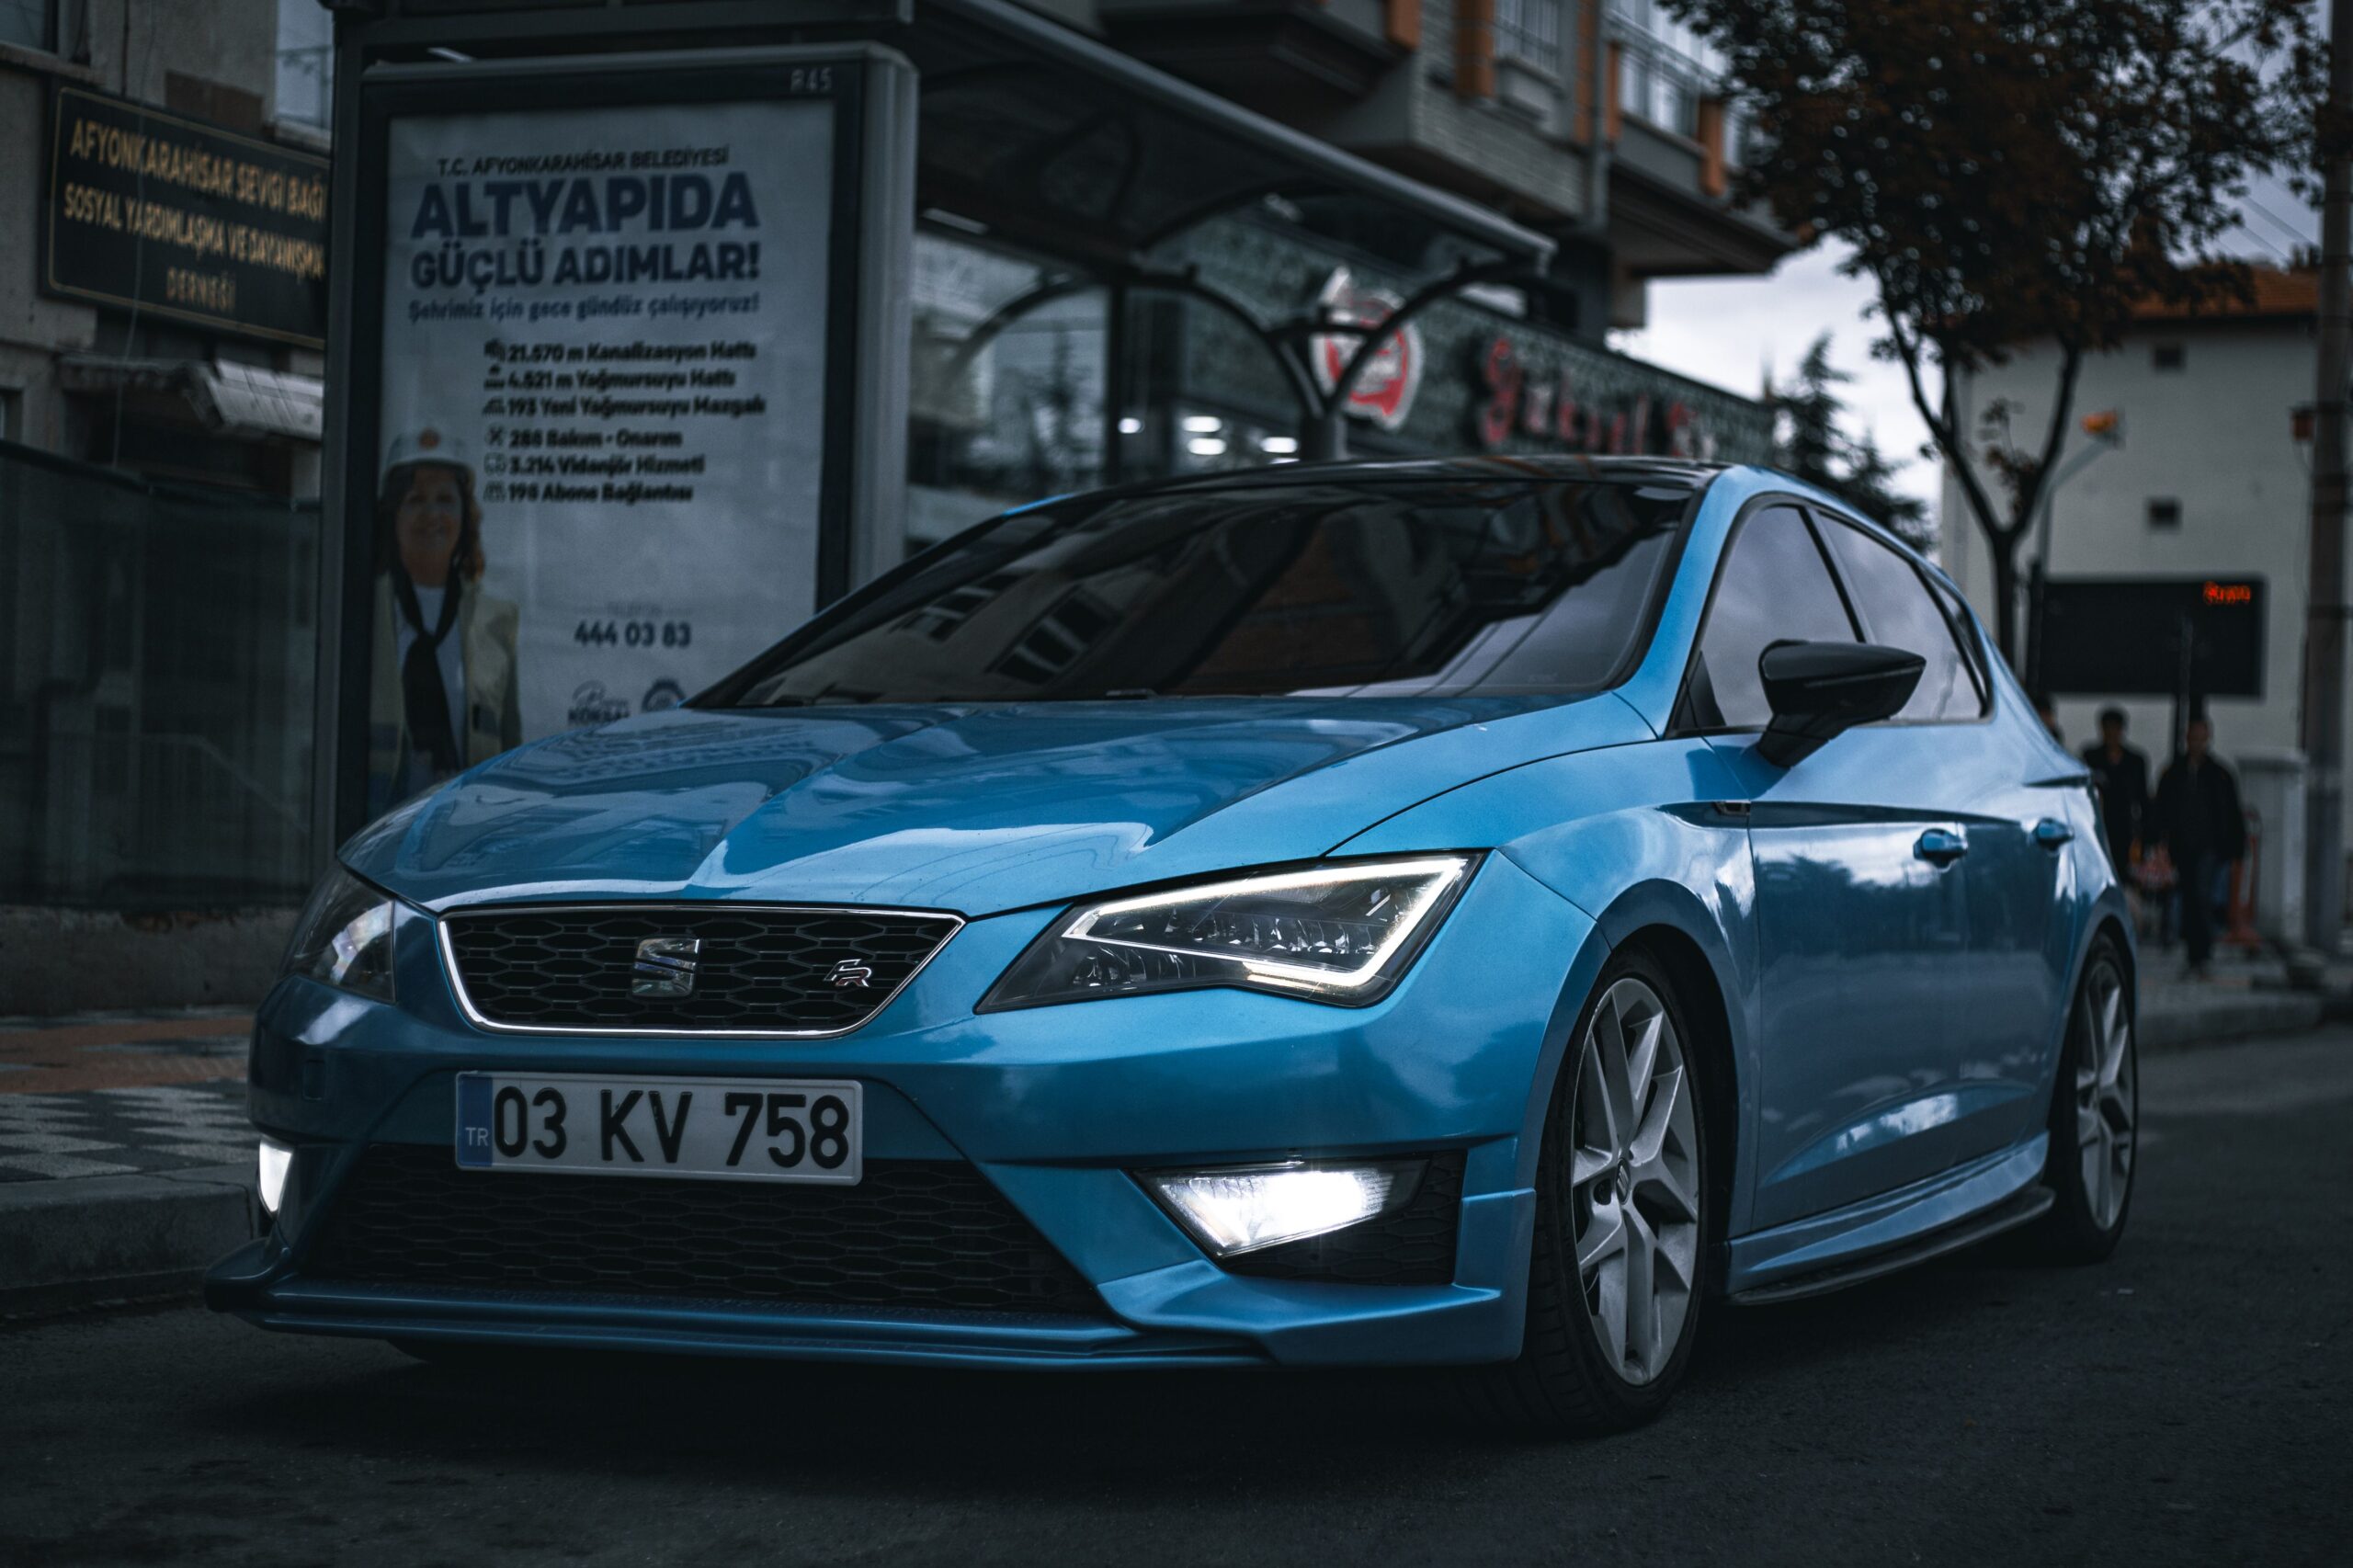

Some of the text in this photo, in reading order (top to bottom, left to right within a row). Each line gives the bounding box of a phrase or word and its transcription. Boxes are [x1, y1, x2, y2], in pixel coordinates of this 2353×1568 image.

[438, 143, 730, 177] T.C. AFYONKARAHİSAR BELEDİYESİ
[410, 171, 760, 240] ALTYAPIDA
[63, 181, 122, 231] SOSYAL
[227, 222, 249, 262] VE
[411, 238, 761, 295] GÜÇLÜ ADIMLAR!
[409, 290, 760, 323] Şehrimiz için gece gündüz çalışıyoruz!
[566, 347, 585, 361] m
[586, 341, 707, 364] Kanalizasyon
[710, 340, 756, 359] Hattı
[555, 373, 573, 388] m
[575, 368, 687, 392] Yağmursuyu
[690, 368, 735, 387] Hattı
[540, 395, 576, 415] Yeni
[579, 395, 689, 419] Yağmursuyu
[545, 426, 603, 448] Bakım
[616, 427, 683, 447] Onarım
[634, 452, 705, 473] Hizmeti
[540, 481, 597, 501] Abone
[574, 619, 692, 647] 444 03 83
[465, 1127, 489, 1147] TR
[494, 1086, 849, 1170] 03 KV 758
